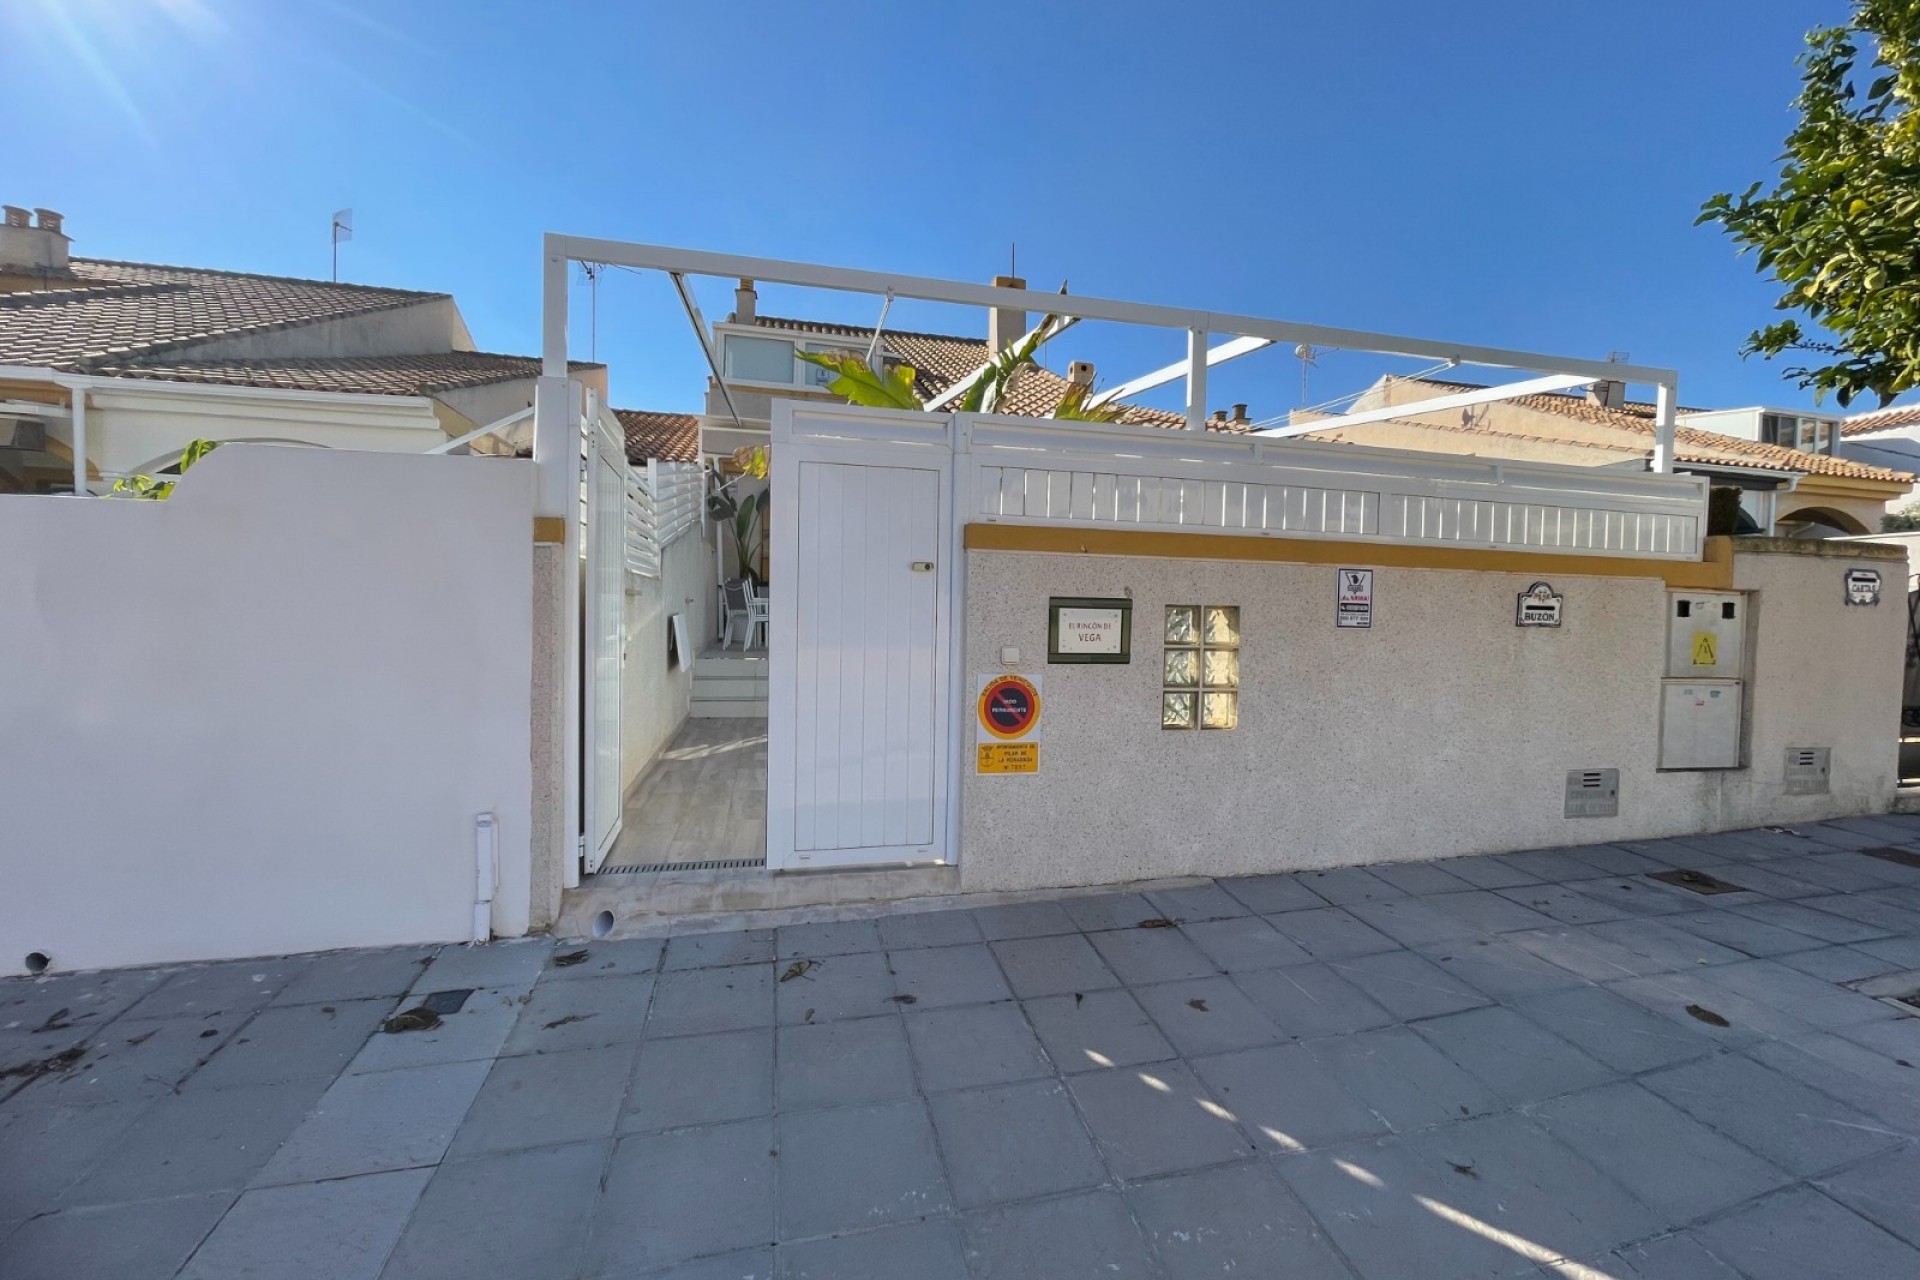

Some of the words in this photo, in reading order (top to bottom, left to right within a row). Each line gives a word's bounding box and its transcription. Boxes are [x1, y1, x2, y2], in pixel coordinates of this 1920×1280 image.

[1852, 583, 1877, 593] CARTAS
[1068, 622, 1076, 630] EL
[1077, 621, 1103, 630] RINCÓN
[1078, 633, 1102, 642] VEGA
